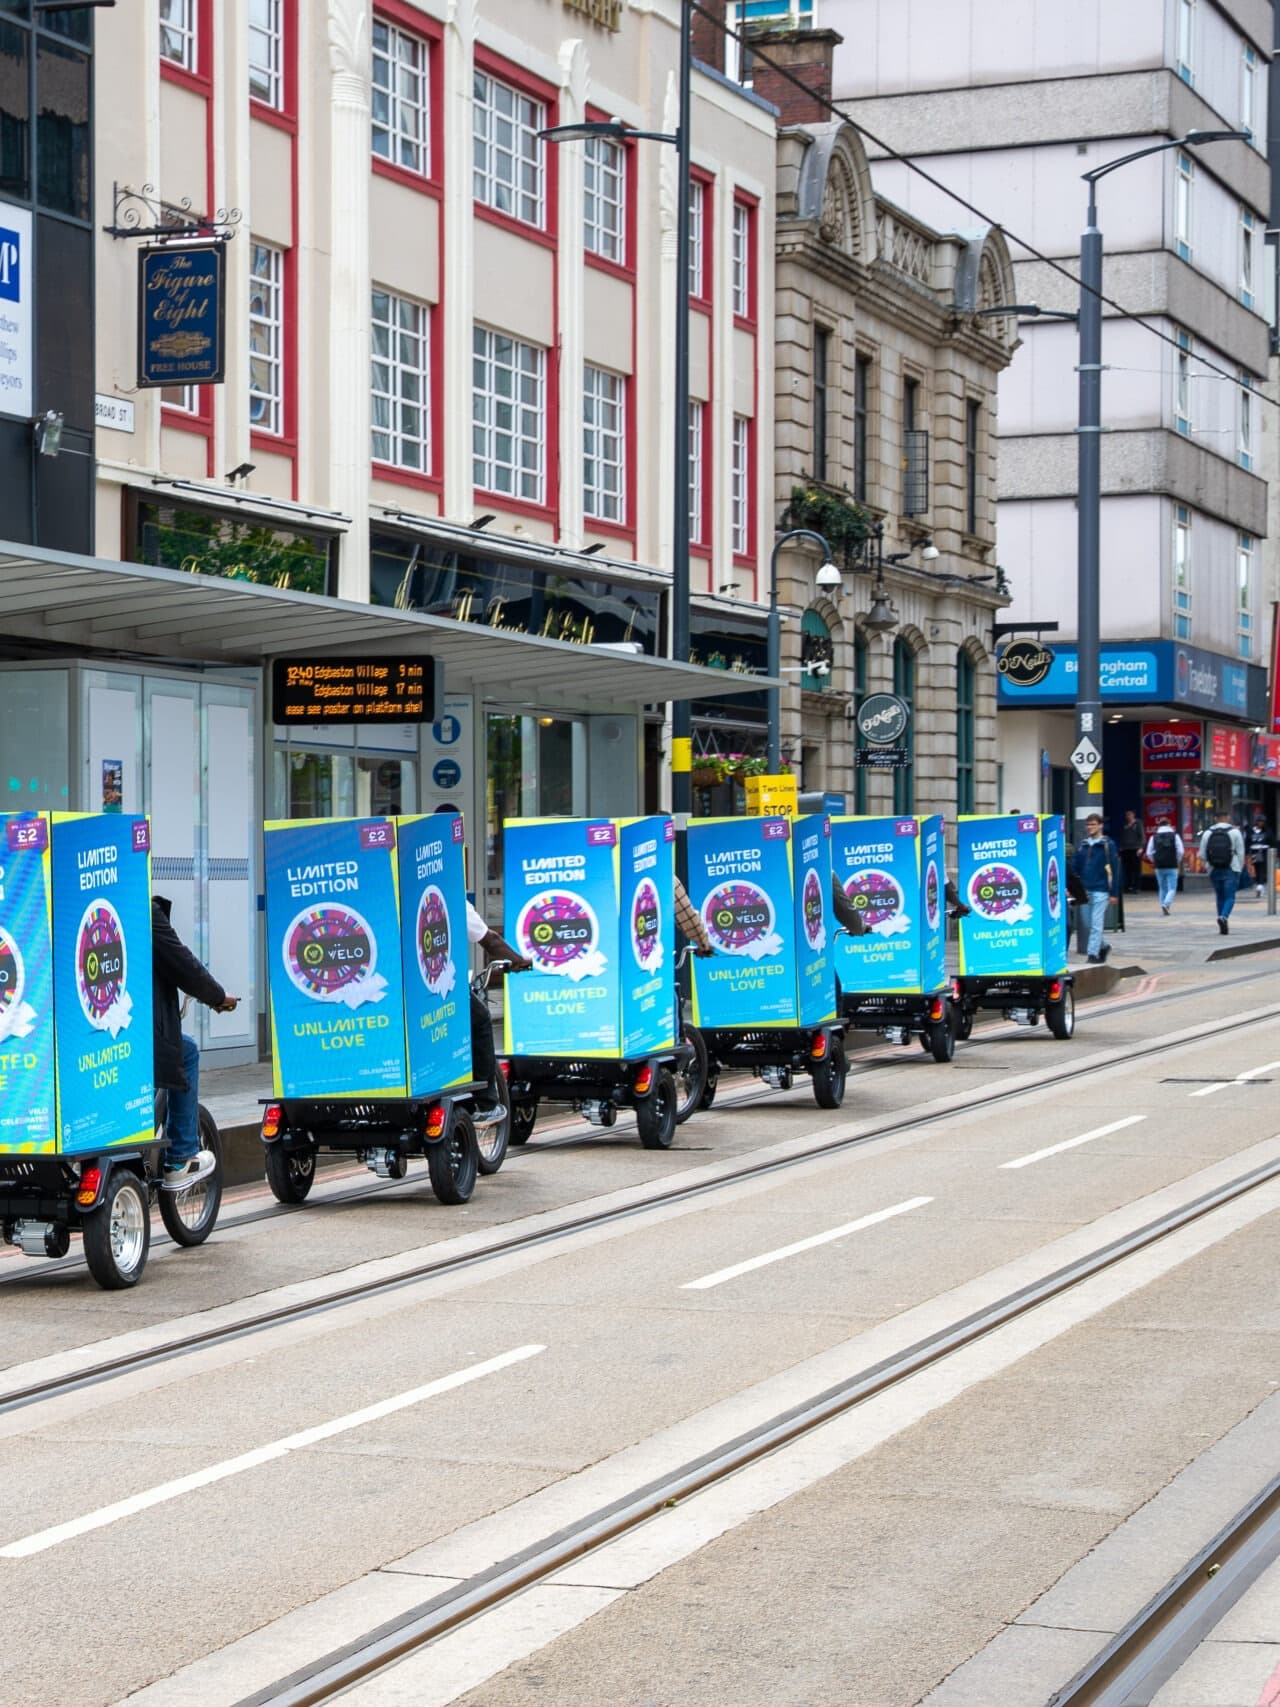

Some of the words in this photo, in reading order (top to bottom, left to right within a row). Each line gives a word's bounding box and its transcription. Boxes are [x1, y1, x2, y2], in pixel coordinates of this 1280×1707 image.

[169, 256, 192, 269] The
[147, 269, 214, 297] Figure
[175, 289, 189, 306] of
[153, 299, 210, 329] Eight
[150, 362, 175, 373] FREE
[177, 359, 211, 371] HOUSE
[95, 403, 116, 420] BROAD
[119, 409, 128, 421] ST
[997, 653, 1052, 673] O'Neill's
[1065, 660, 1147, 675] Bingham
[314, 666, 354, 679] Edgbaston
[357, 665, 388, 679] Village
[400, 665, 406, 677] 9
[408, 664, 423, 677] min
[1099, 674, 1147, 686] Central
[314, 684, 354, 697] Edgbaston
[357, 683, 388, 696] Village
[396, 683, 405, 695] 17
[408, 683, 423, 695] min
[307, 705, 321, 715] see
[323, 703, 350, 715] poster
[353, 705, 364, 714] on
[366, 701, 402, 715] platform
[1075, 752, 1097, 764] 30
[1149, 751, 1196, 760] CHICKEN
[764, 805, 792, 816] STOP
[17, 828, 38, 843] £2
[594, 830, 611, 840] £2
[770, 826, 783, 835] £2
[900, 825, 913, 833] £2
[136, 830, 146, 843] £2
[368, 831, 386, 842] £2
[415, 840, 442, 862] LIMITED
[844, 843, 893, 856] LIMITED
[972, 839, 1017, 851] LIMITED
[77, 845, 118, 869] LIMITED
[704, 849, 761, 865] LIMITED
[846, 854, 893, 866] EDITION
[973, 849, 1017, 861] EDITION
[417, 858, 443, 880] EDITION
[522, 855, 586, 871] LIMITED
[707, 861, 761, 876] EDITION
[79, 866, 118, 890] EDITION
[287, 860, 358, 882] LIMITED
[525, 869, 586, 885] EDITION
[291, 877, 359, 898] EDITION
[996, 889, 1019, 897] VELO
[870, 898, 895, 906] VELO
[736, 914, 765, 923] VELO
[432, 934, 447, 947] VELO
[556, 928, 588, 939] VELO
[973, 927, 1033, 940] UNLIMITED
[845, 940, 911, 954] UNLIMITED
[990, 938, 1018, 949] LOVE
[328, 947, 364, 960] VELO
[863, 952, 894, 963] LOVE
[100, 958, 120, 975] VELO
[708, 964, 784, 981] UNLIMITED
[730, 979, 765, 992] LOVE
[524, 986, 607, 1003] UNLIMITED
[547, 1002, 586, 1015] LOVE
[420, 1002, 456, 1030] UNLIMITED
[293, 1015, 390, 1037] UNLIMITED
[431, 1023, 448, 1044] LOVE
[320, 1032, 366, 1051] LOVE
[78, 1041, 131, 1073] UNLIMITED
[93, 1066, 119, 1089] LOVE
